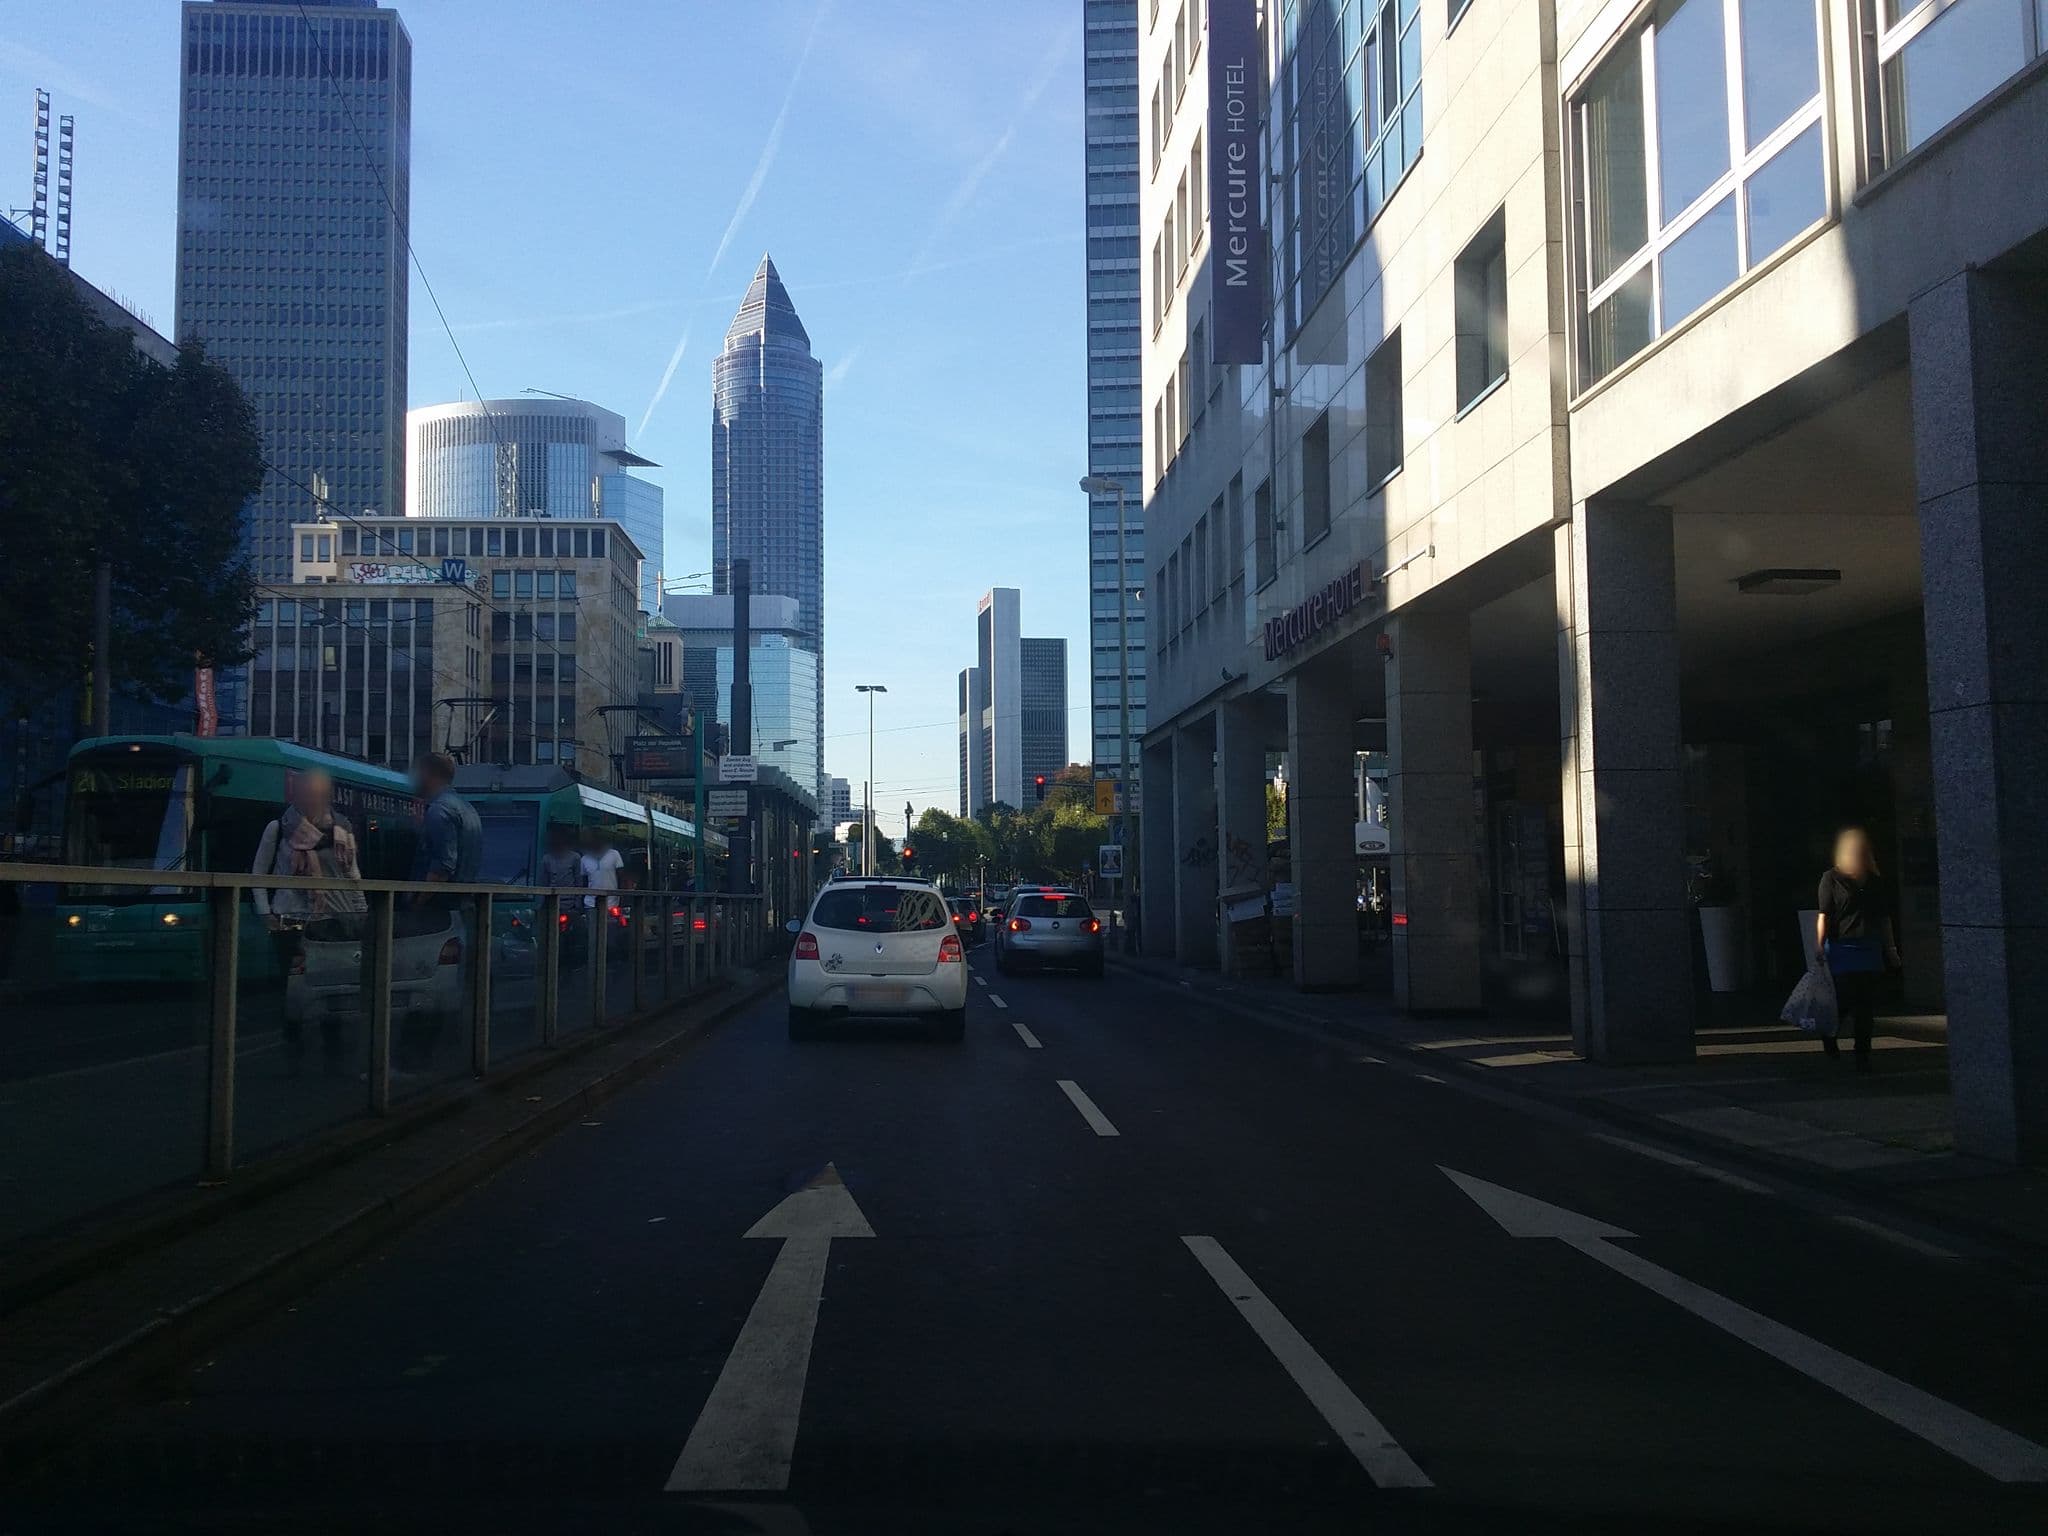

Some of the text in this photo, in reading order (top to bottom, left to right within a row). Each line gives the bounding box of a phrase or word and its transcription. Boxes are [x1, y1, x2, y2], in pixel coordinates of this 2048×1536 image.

[1226, 57, 1248, 286] Mercure HOTEL
[443, 561, 464, 579] W
[1264, 561, 1375, 661] Mercure HOTEL
